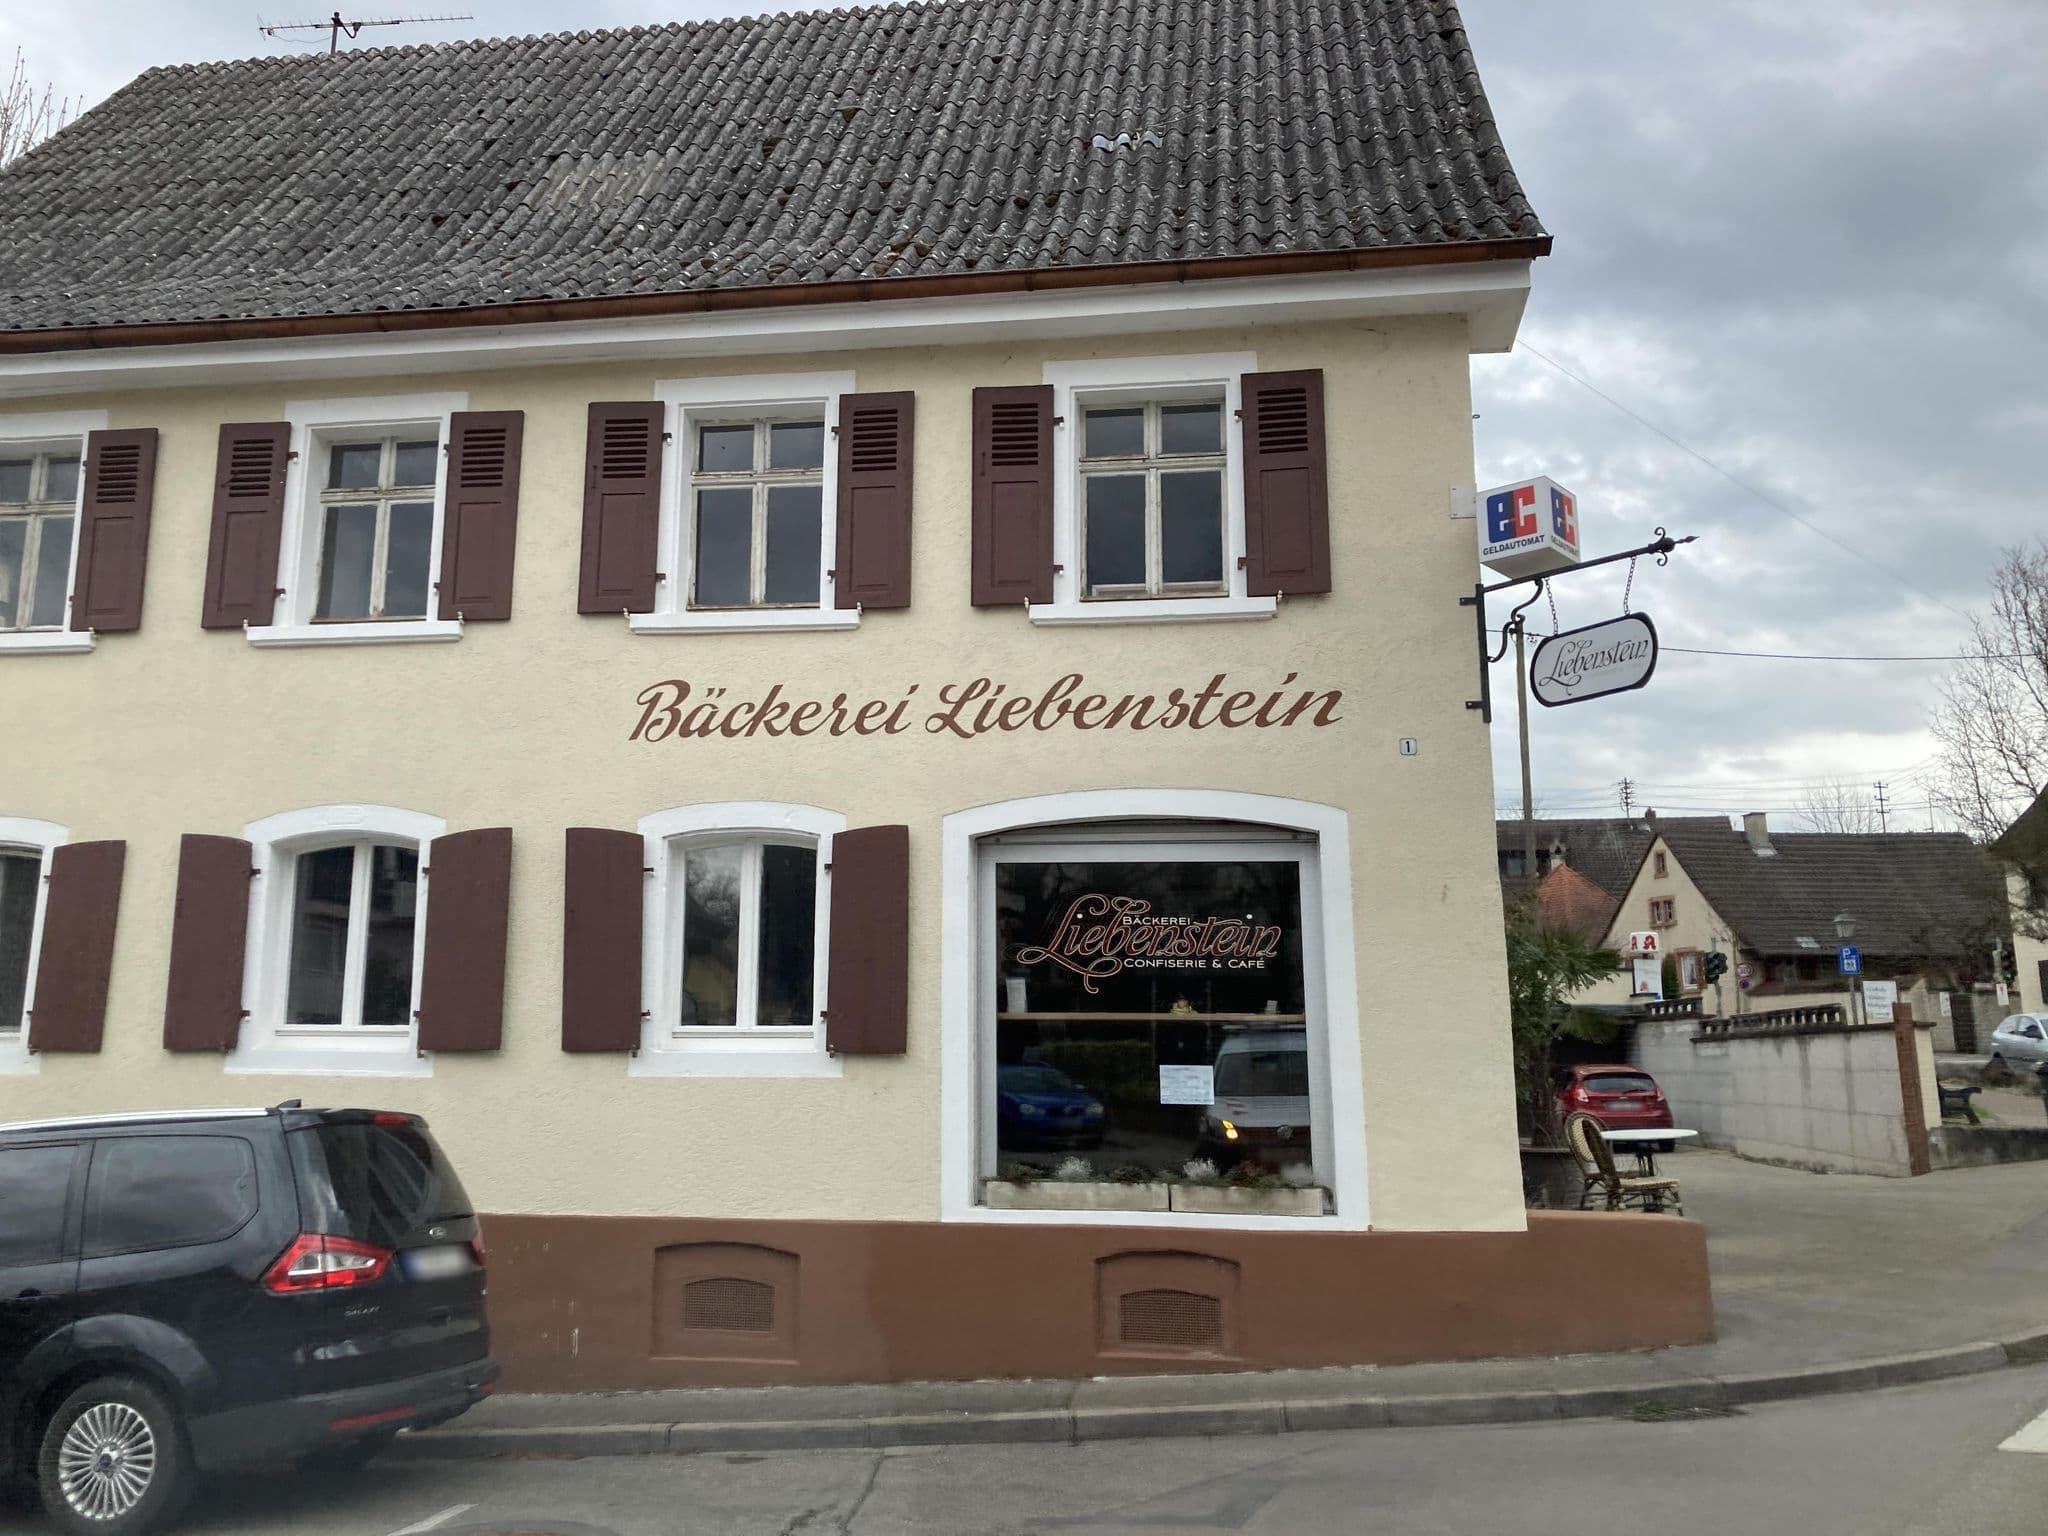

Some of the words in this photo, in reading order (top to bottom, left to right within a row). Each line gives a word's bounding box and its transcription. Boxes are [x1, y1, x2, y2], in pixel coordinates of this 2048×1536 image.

[1482, 535, 1545, 556] GELDAUTOMAT
[1538, 639, 1649, 697] Liebenstein
[629, 679, 918, 742] Bäckerei
[925, 672, 1343, 738] Liebenstein
[1405, 740, 1410, 753] 1
[1122, 914, 1191, 926] BÄCKEREI
[1017, 894, 1282, 994] Liebenstein
[1842, 947, 1851, 959] P
[1123, 958, 1207, 968] CONFISERIE
[1212, 958, 1222, 969] &
[1228, 957, 1265, 969] CAFÉ
